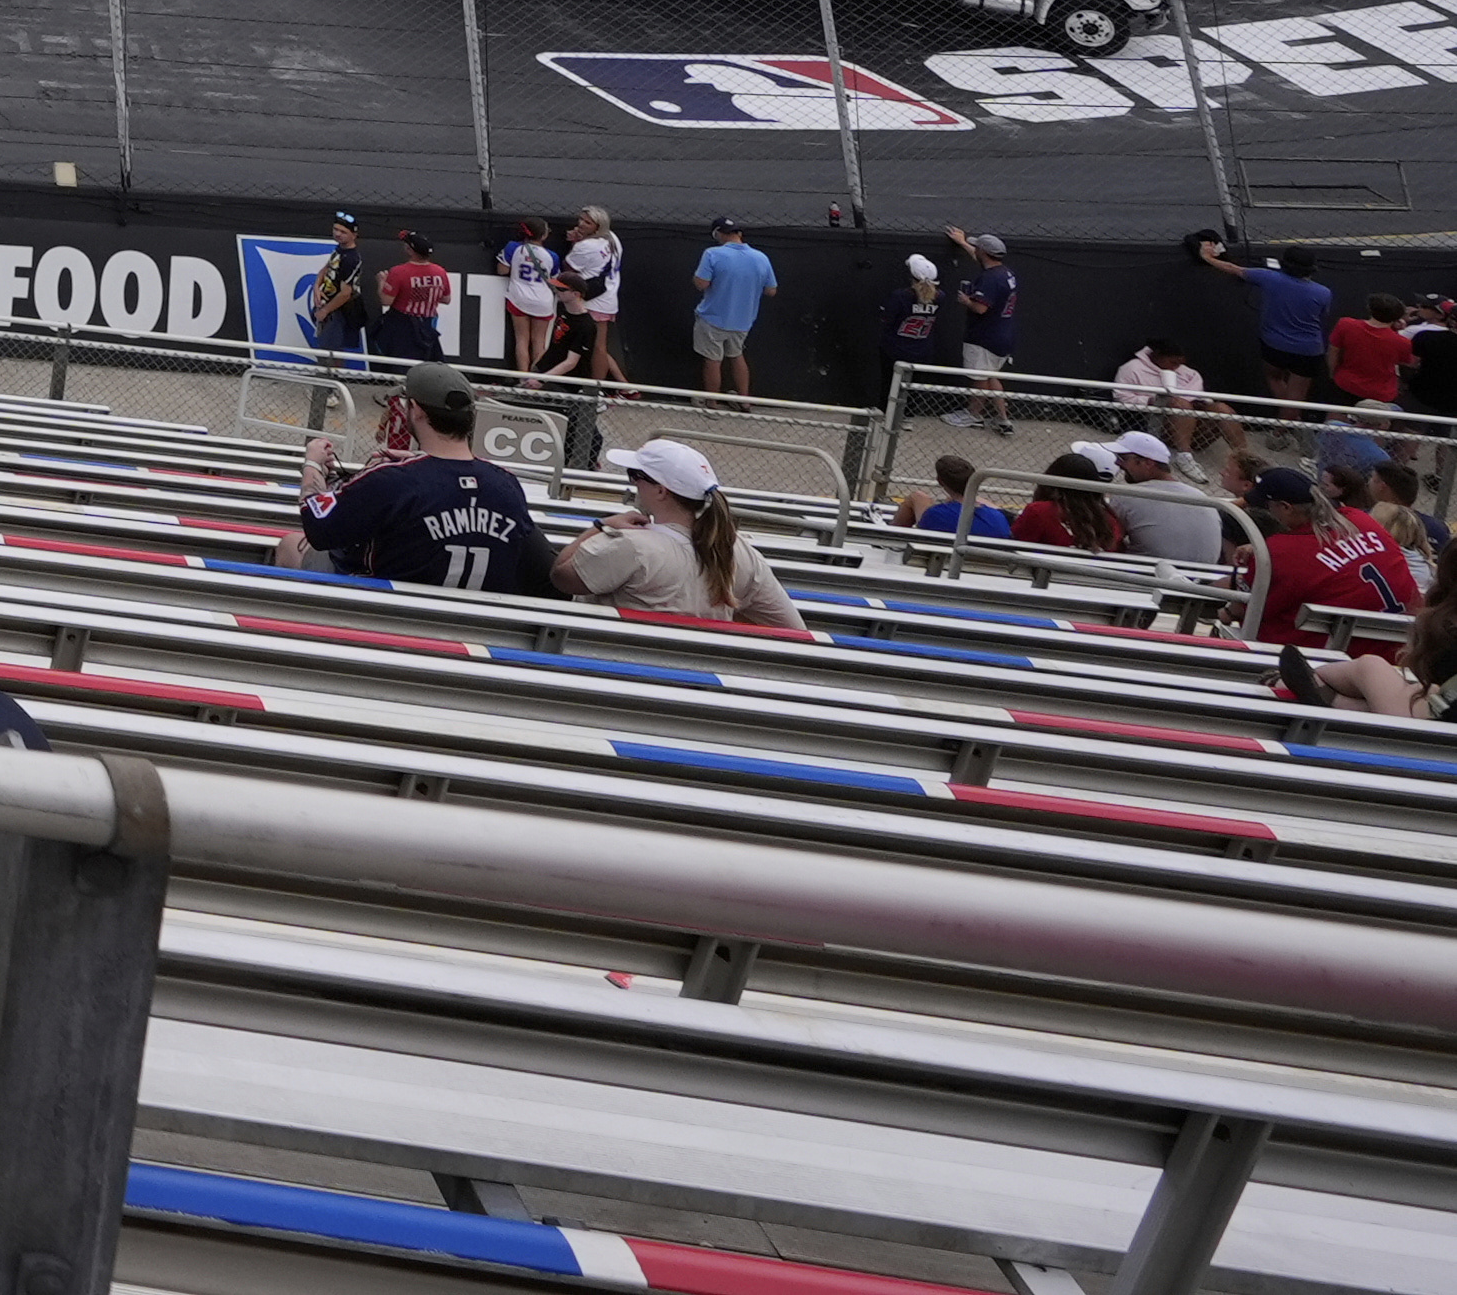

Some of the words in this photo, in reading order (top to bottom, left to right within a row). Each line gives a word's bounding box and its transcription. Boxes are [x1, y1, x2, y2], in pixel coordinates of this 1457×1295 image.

[912, 304, 938, 314] RILEY
[484, 427, 558, 461] CC
[423, 497, 516, 543] RAMÍREZ
[444, 545, 490, 589] 11
[1315, 531, 1386, 573] ALBIES
[1359, 562, 1406, 613] 1
